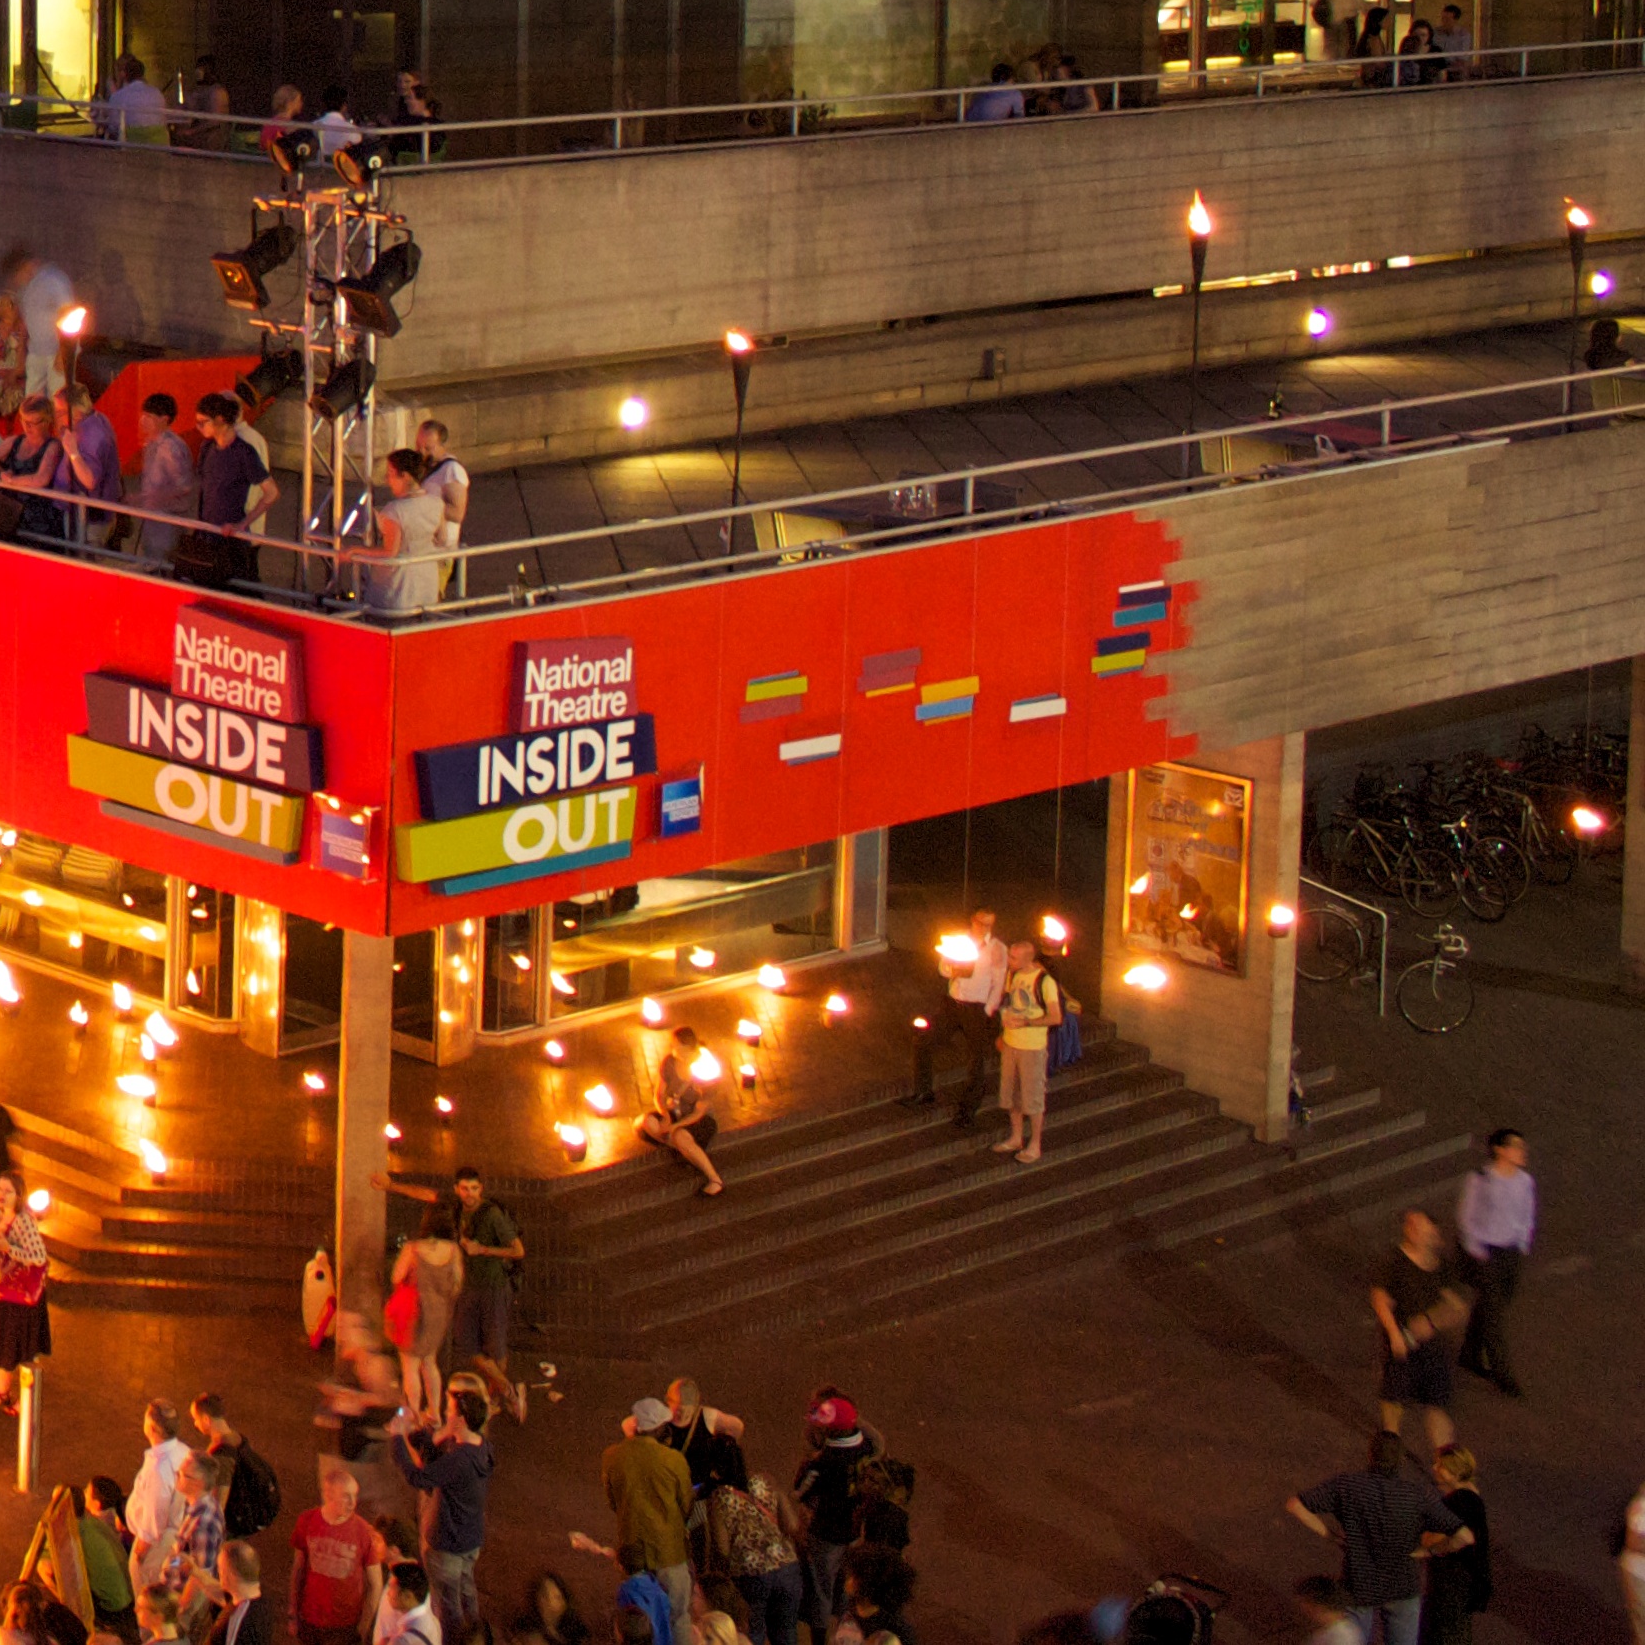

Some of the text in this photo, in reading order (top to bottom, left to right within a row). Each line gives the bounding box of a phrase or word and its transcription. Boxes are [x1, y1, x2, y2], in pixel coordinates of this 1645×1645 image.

[174, 658, 283, 718] Theatre
[175, 624, 286, 686] National
[524, 646, 634, 694] National
[128, 687, 287, 785] INSIDE
[524, 683, 628, 730] Theatre
[477, 719, 636, 806] INSIDE
[154, 763, 284, 845] OUT
[502, 786, 638, 866] OUT
